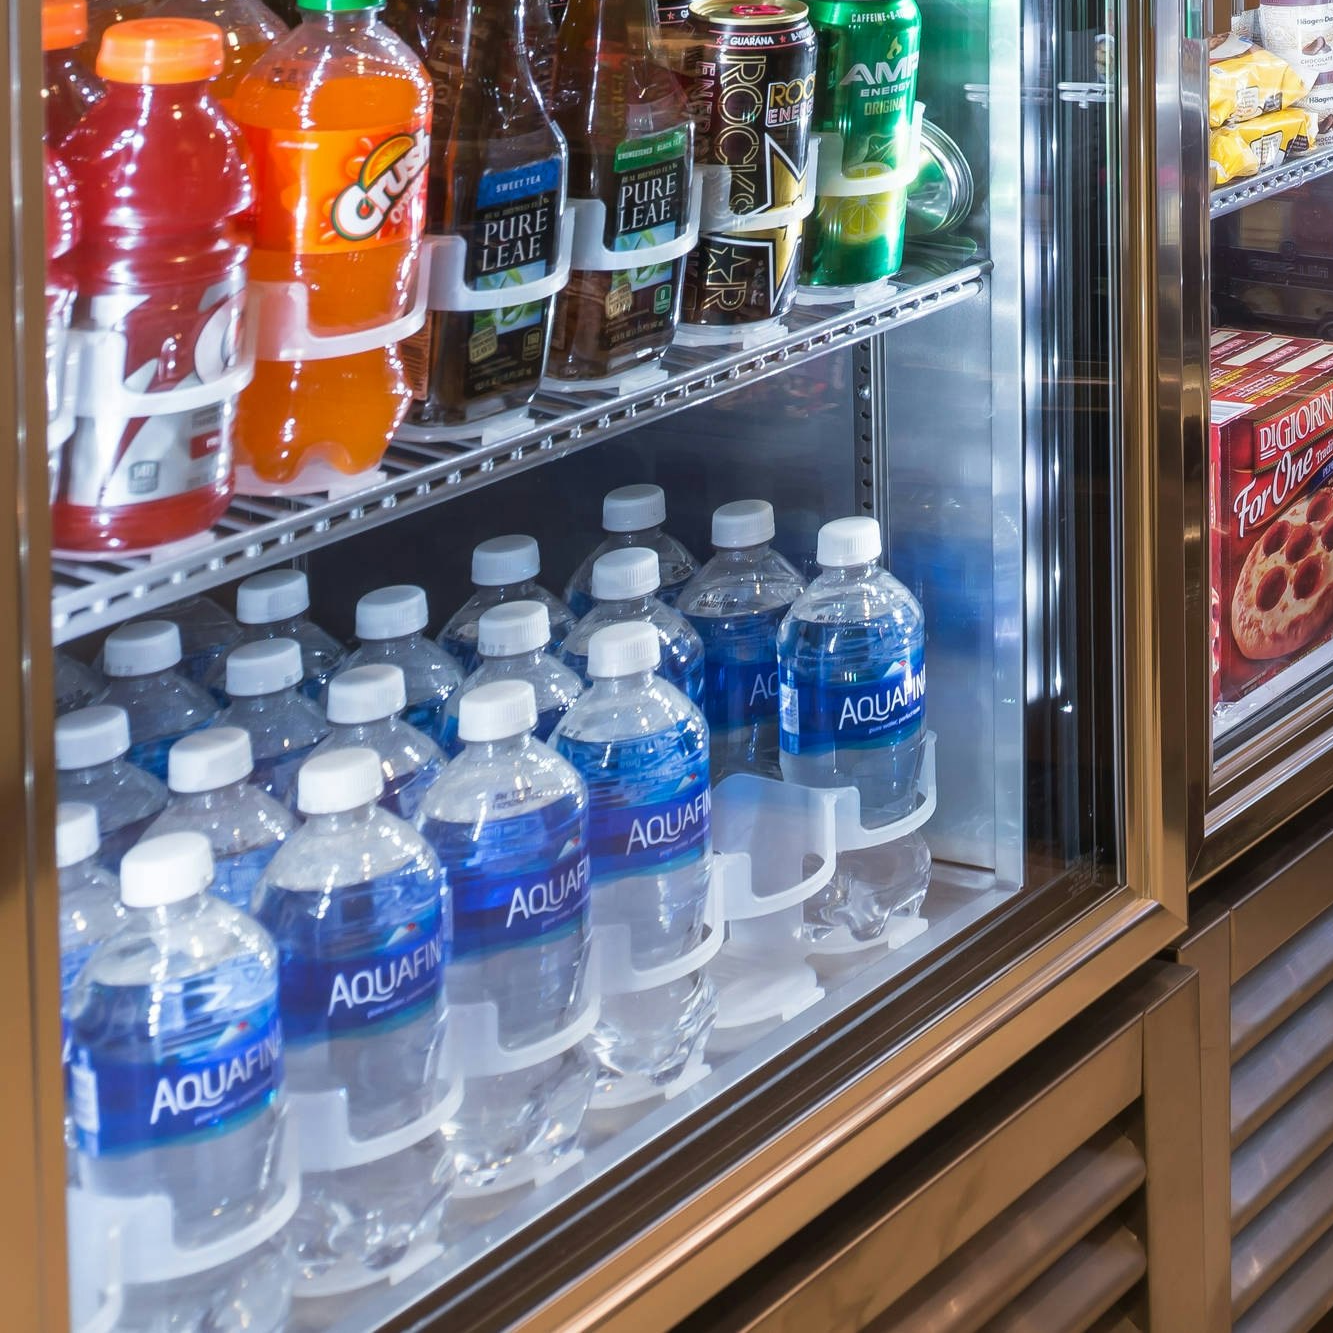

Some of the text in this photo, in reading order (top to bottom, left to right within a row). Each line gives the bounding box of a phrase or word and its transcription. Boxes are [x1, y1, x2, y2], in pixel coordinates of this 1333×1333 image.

[729, 35, 774, 47] GUARANA
[860, 82, 912, 98] ENERGY
[496, 175, 541, 193] SWEET TEA
[620, 172, 677, 208] PURE
[483, 207, 549, 247] PURE
[1234, 478, 1271, 538] For
[1272, 447, 1314, 506] One
[626, 788, 711, 856] AQUAFIN
[328, 936, 442, 1017] AQUAFIN
